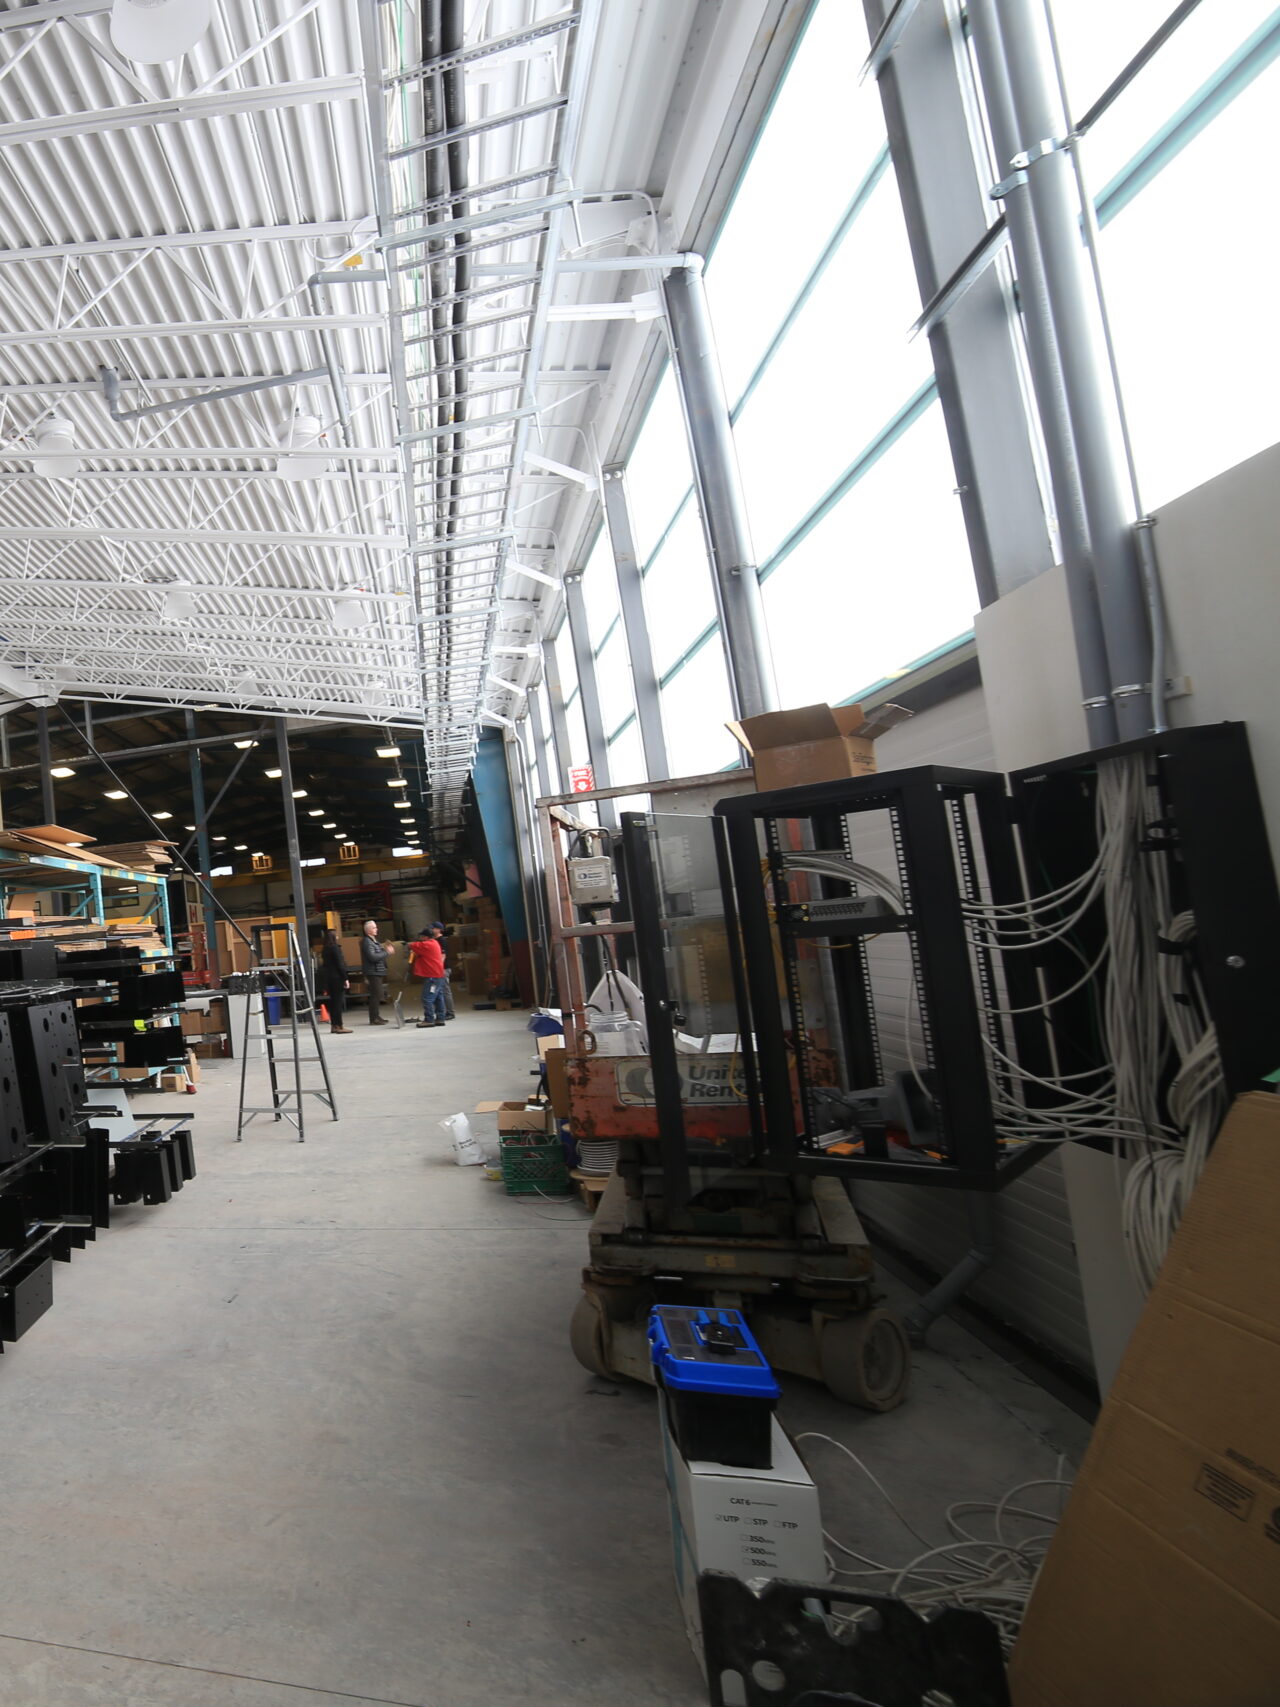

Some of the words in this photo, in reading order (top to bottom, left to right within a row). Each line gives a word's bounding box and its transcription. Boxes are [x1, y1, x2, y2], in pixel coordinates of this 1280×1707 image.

[688, 1063, 747, 1081] Unite
[723, 1515, 740, 1523] UTP
[782, 1521, 798, 1529] FTP
